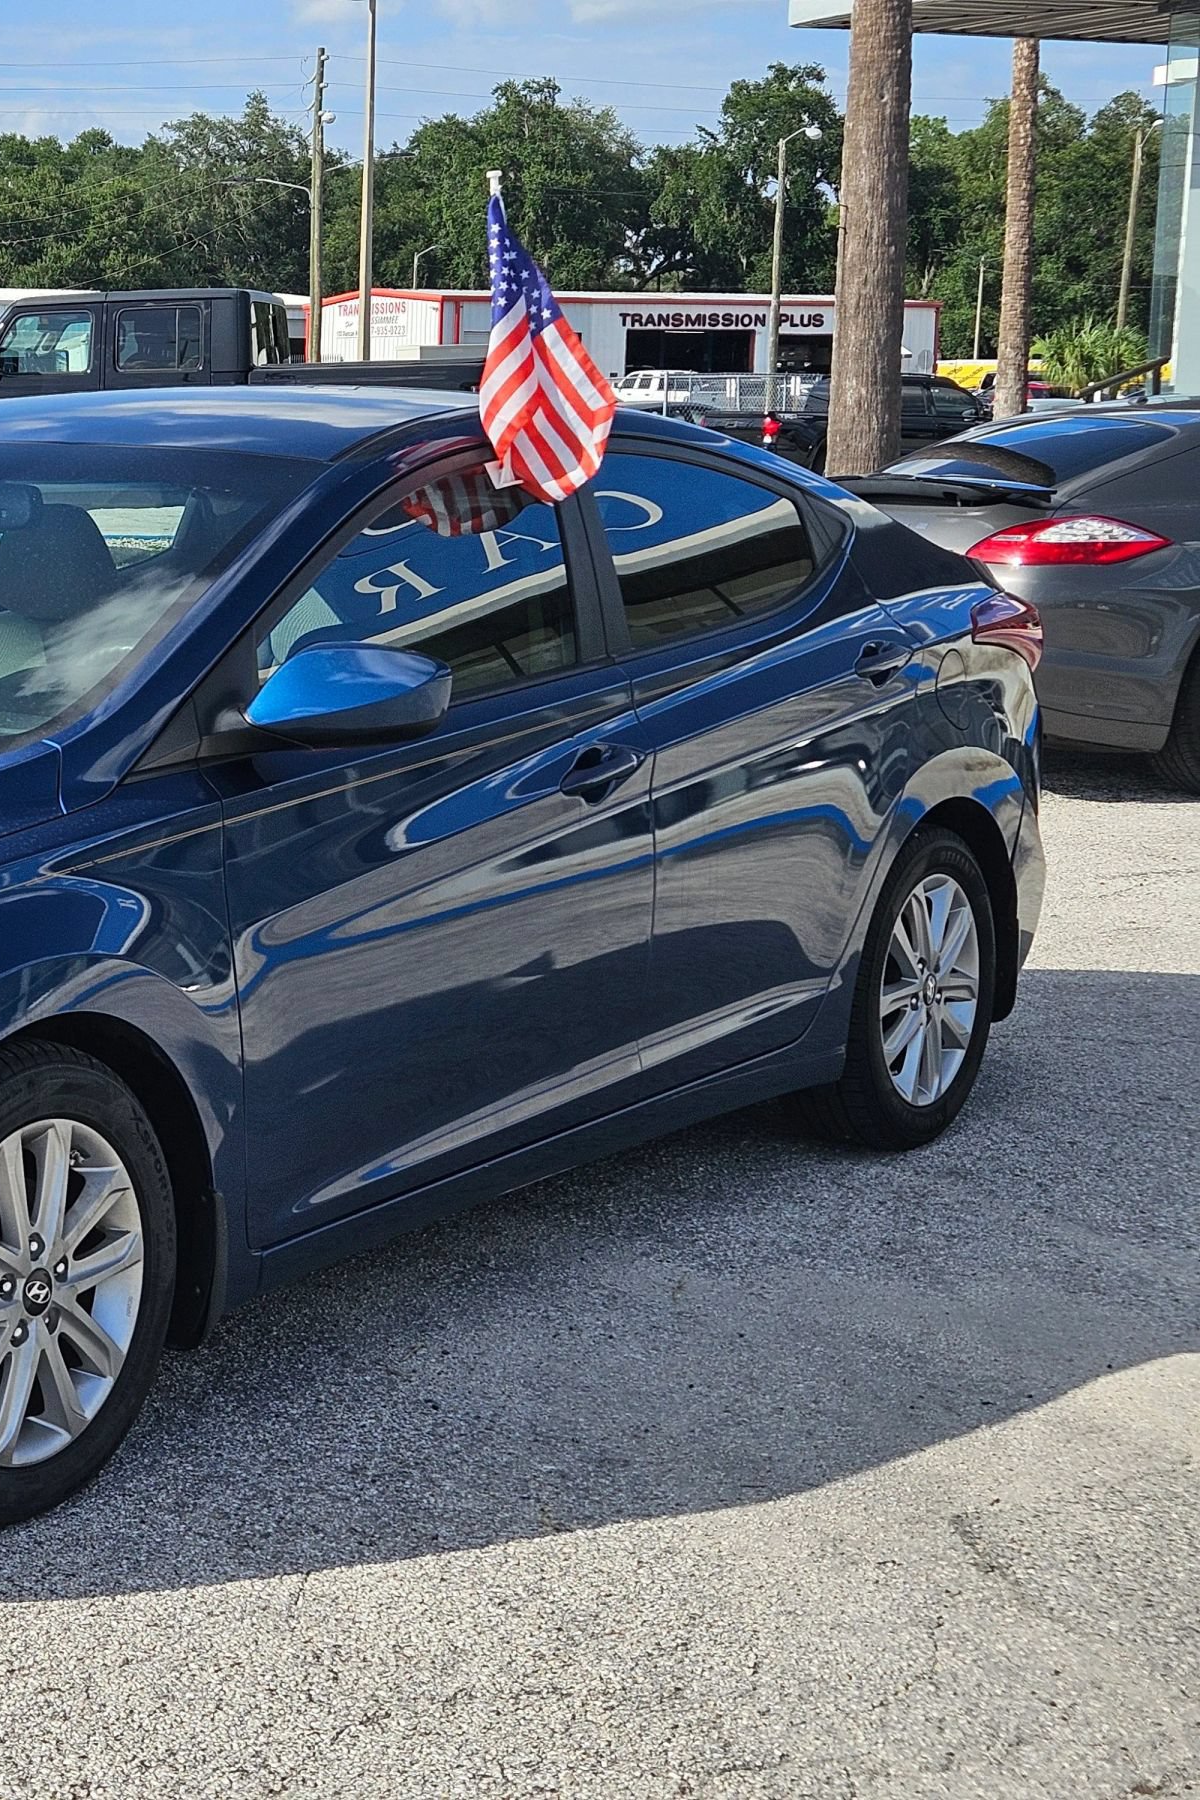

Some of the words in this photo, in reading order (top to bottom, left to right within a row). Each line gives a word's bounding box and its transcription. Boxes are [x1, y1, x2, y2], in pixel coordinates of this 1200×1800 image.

[338, 301, 406, 317] TRANISSIONS
[619, 312, 766, 328] TRANSMISSION
[778, 313, 825, 328] PLUS
